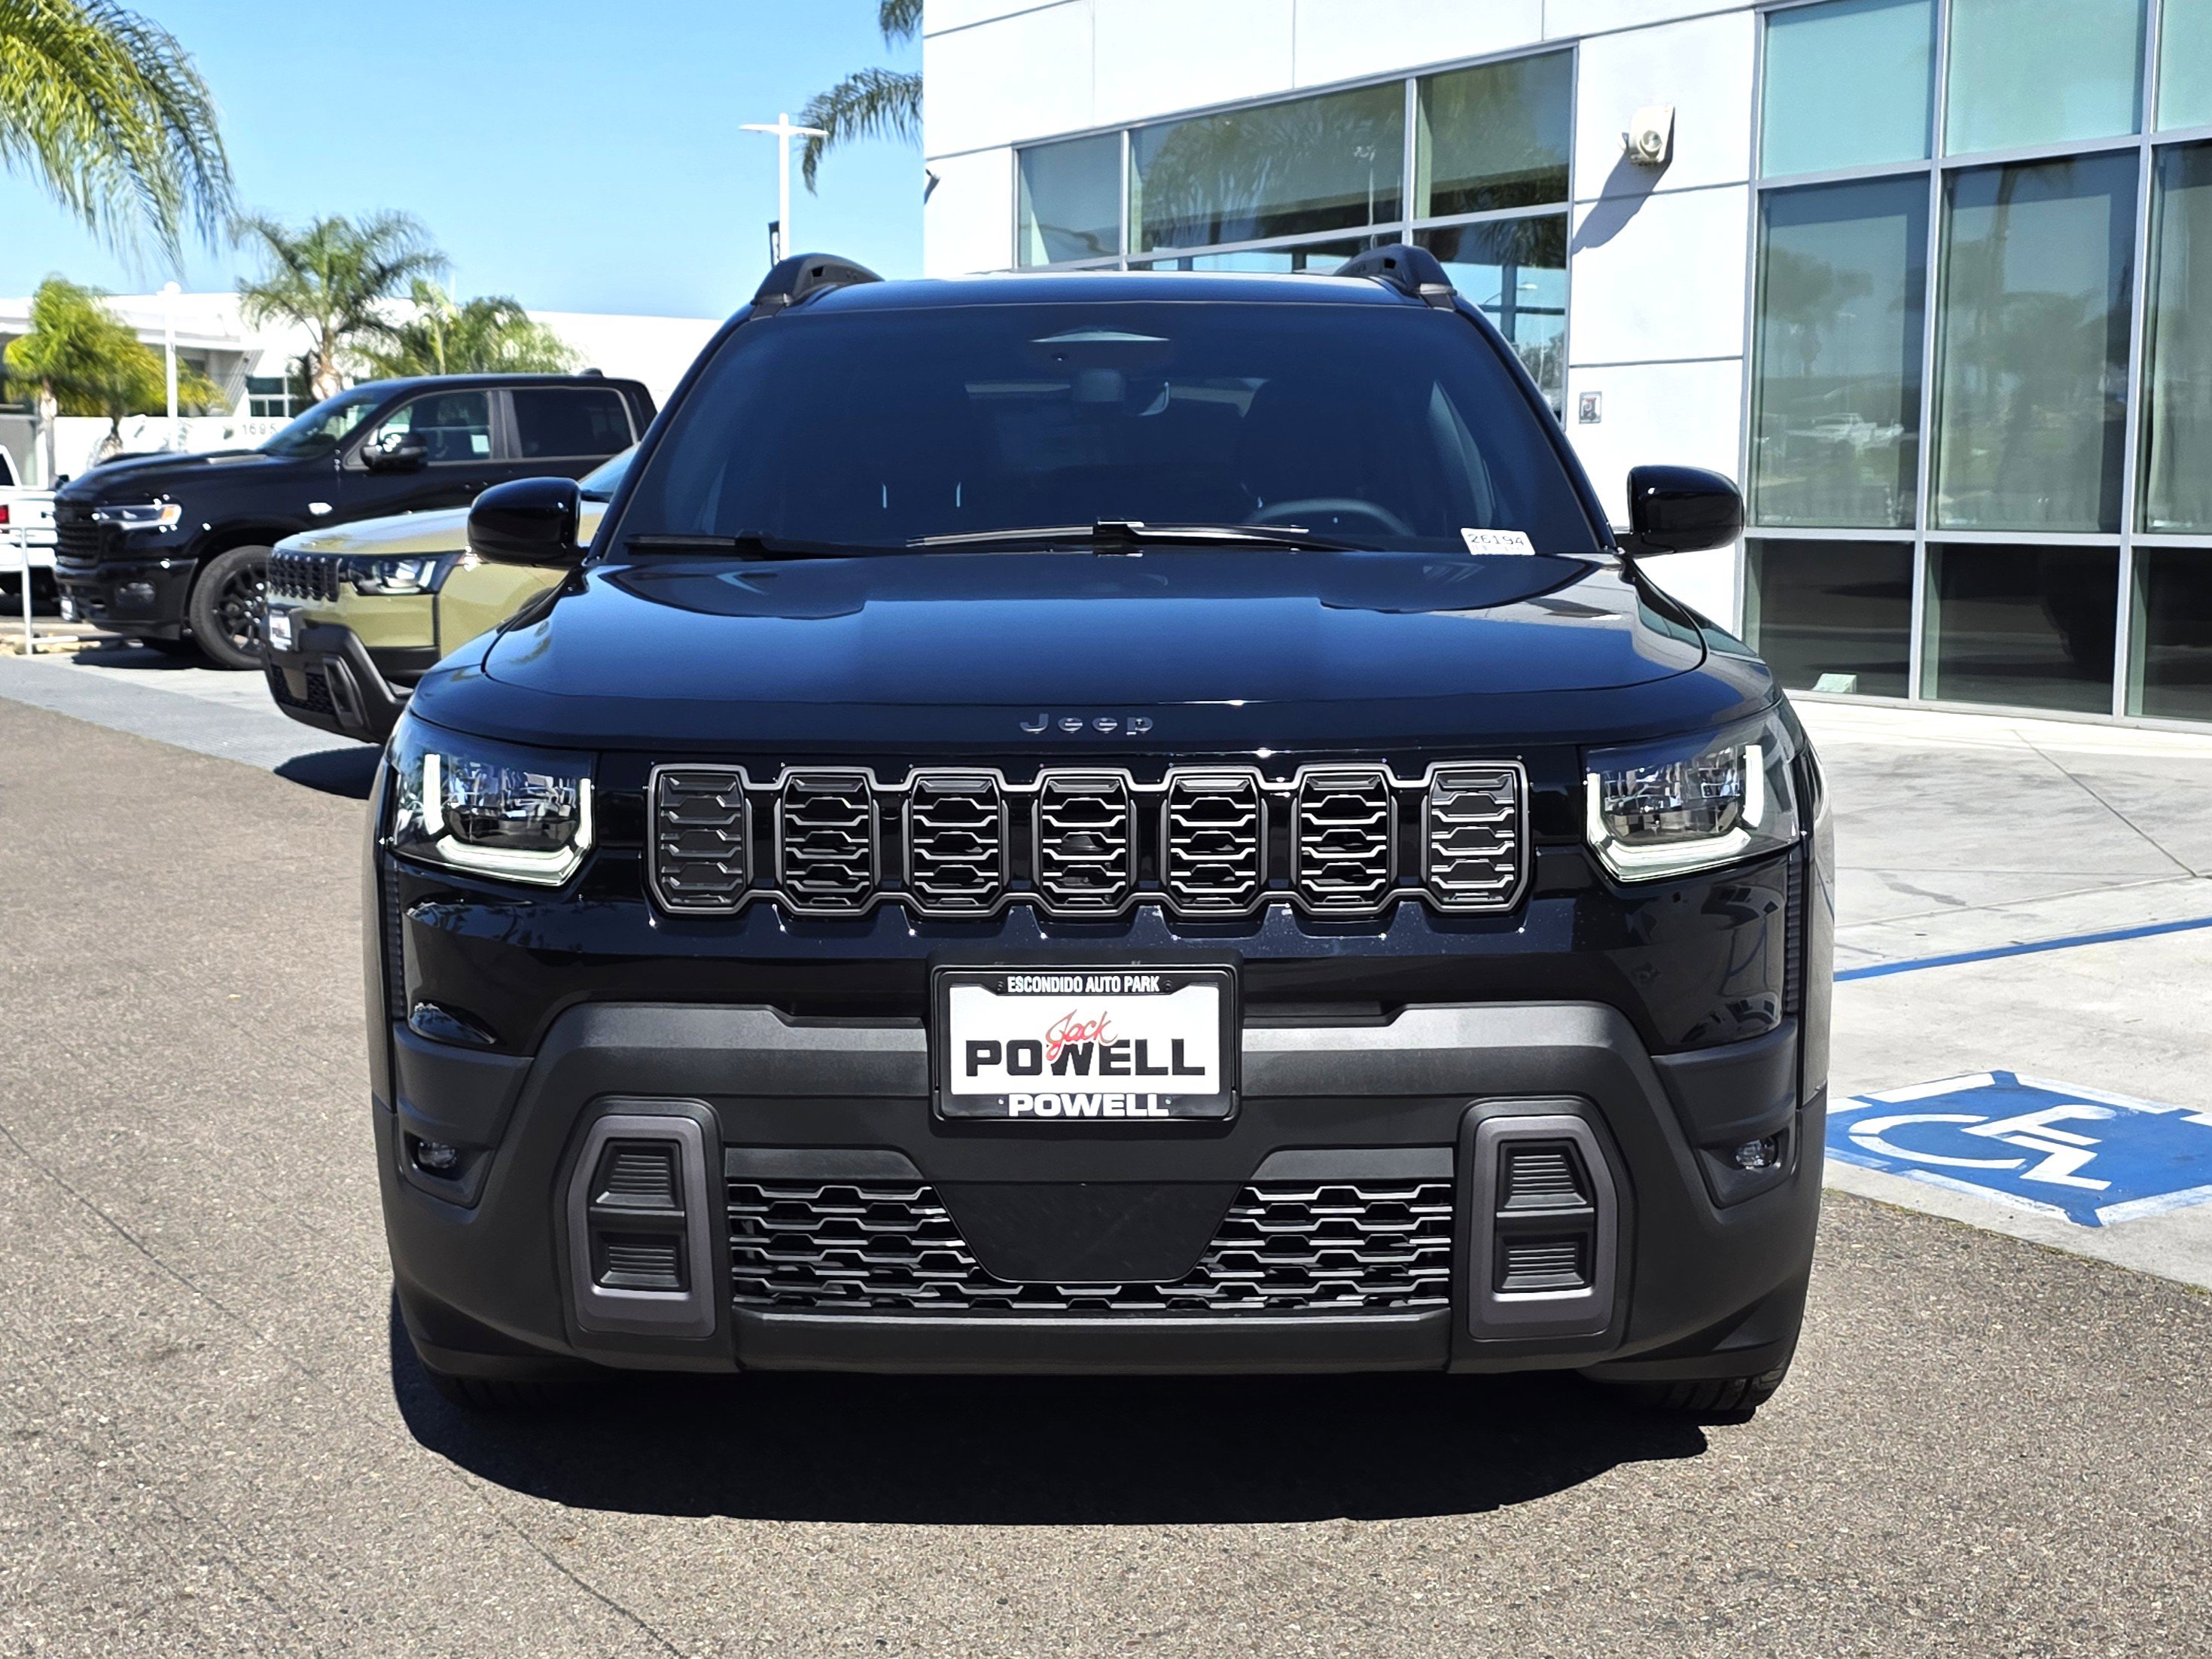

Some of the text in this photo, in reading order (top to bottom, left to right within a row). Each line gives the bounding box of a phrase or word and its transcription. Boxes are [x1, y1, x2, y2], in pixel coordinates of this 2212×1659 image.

[1019, 713, 1153, 736] Jeep
[1007, 975, 1160, 993] ESCONDIDO AUTO PARK
[1045, 1009, 1118, 1062] Jack
[965, 1038, 1205, 1077] POWELL
[1007, 1093, 1170, 1118] POWELL
